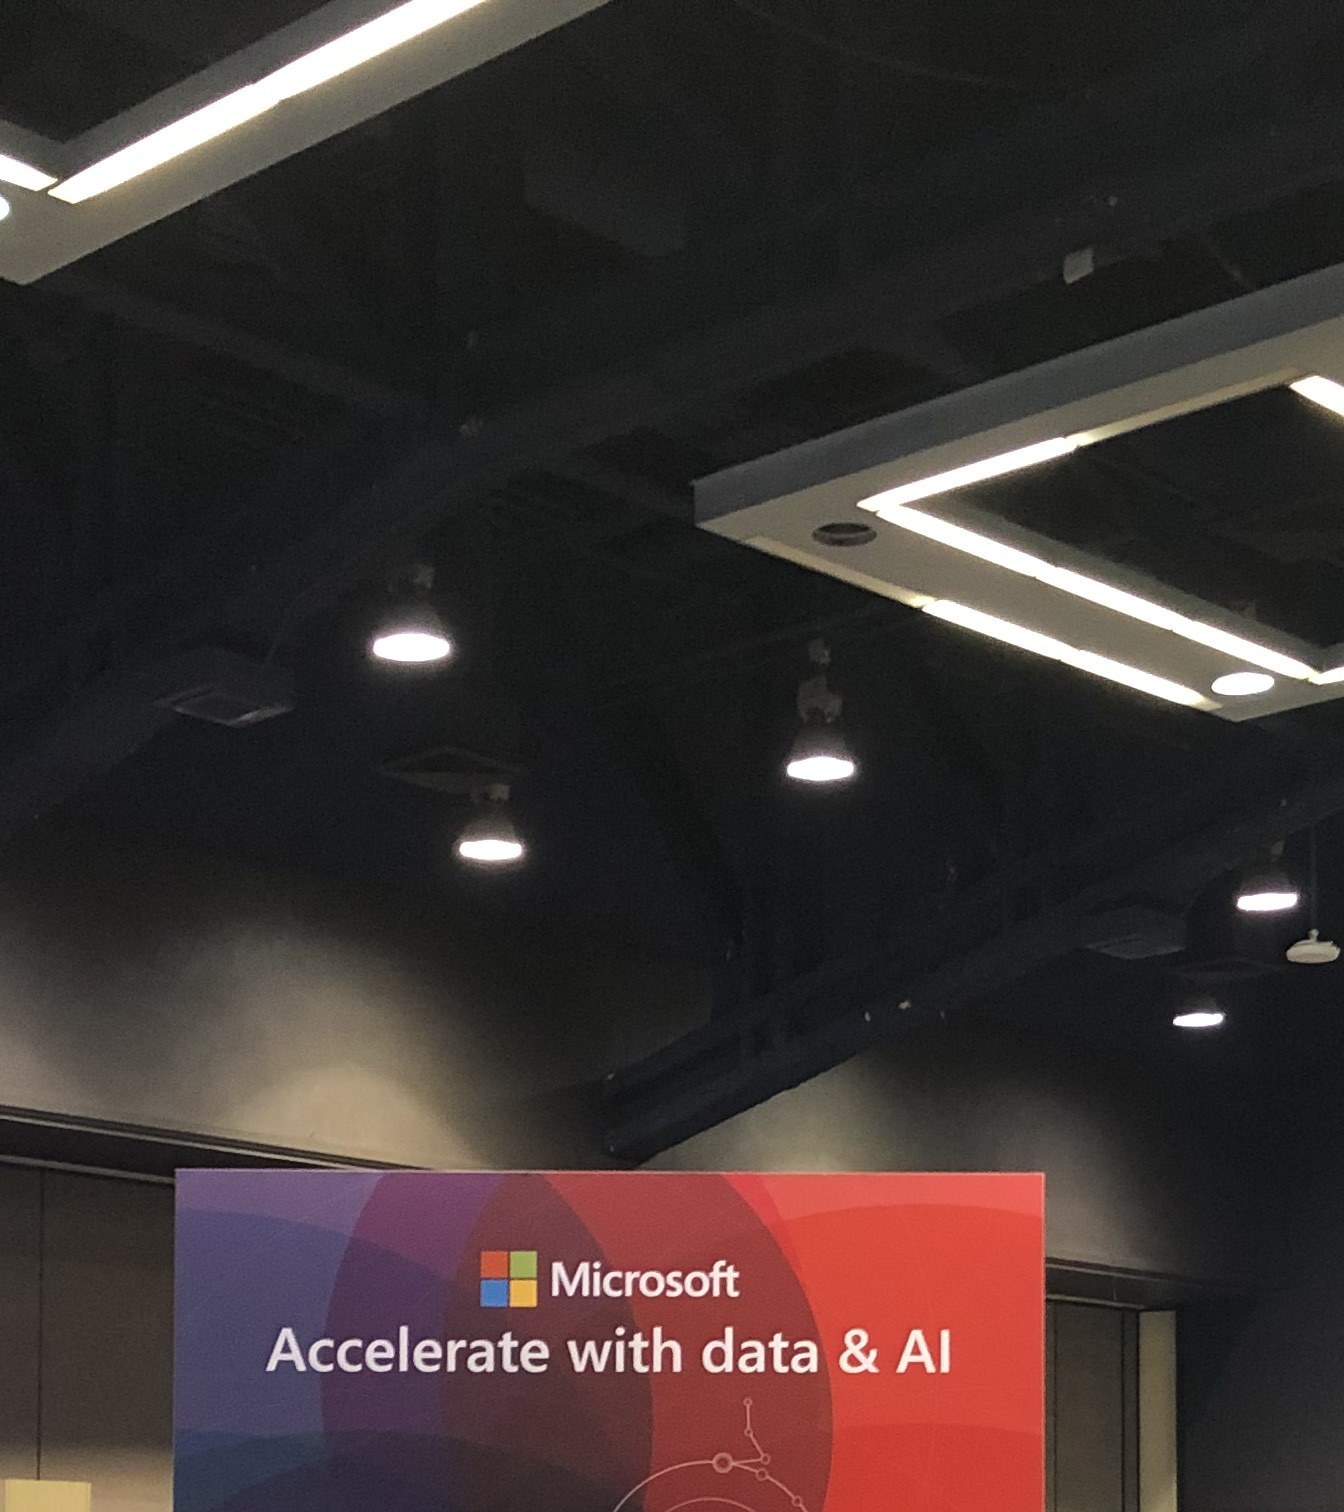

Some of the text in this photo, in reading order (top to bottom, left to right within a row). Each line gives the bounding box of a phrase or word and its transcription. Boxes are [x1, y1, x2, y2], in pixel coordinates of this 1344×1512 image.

[550, 1259, 741, 1299] Microsoft
[265, 1325, 951, 1375] Accelerate with data & AI
